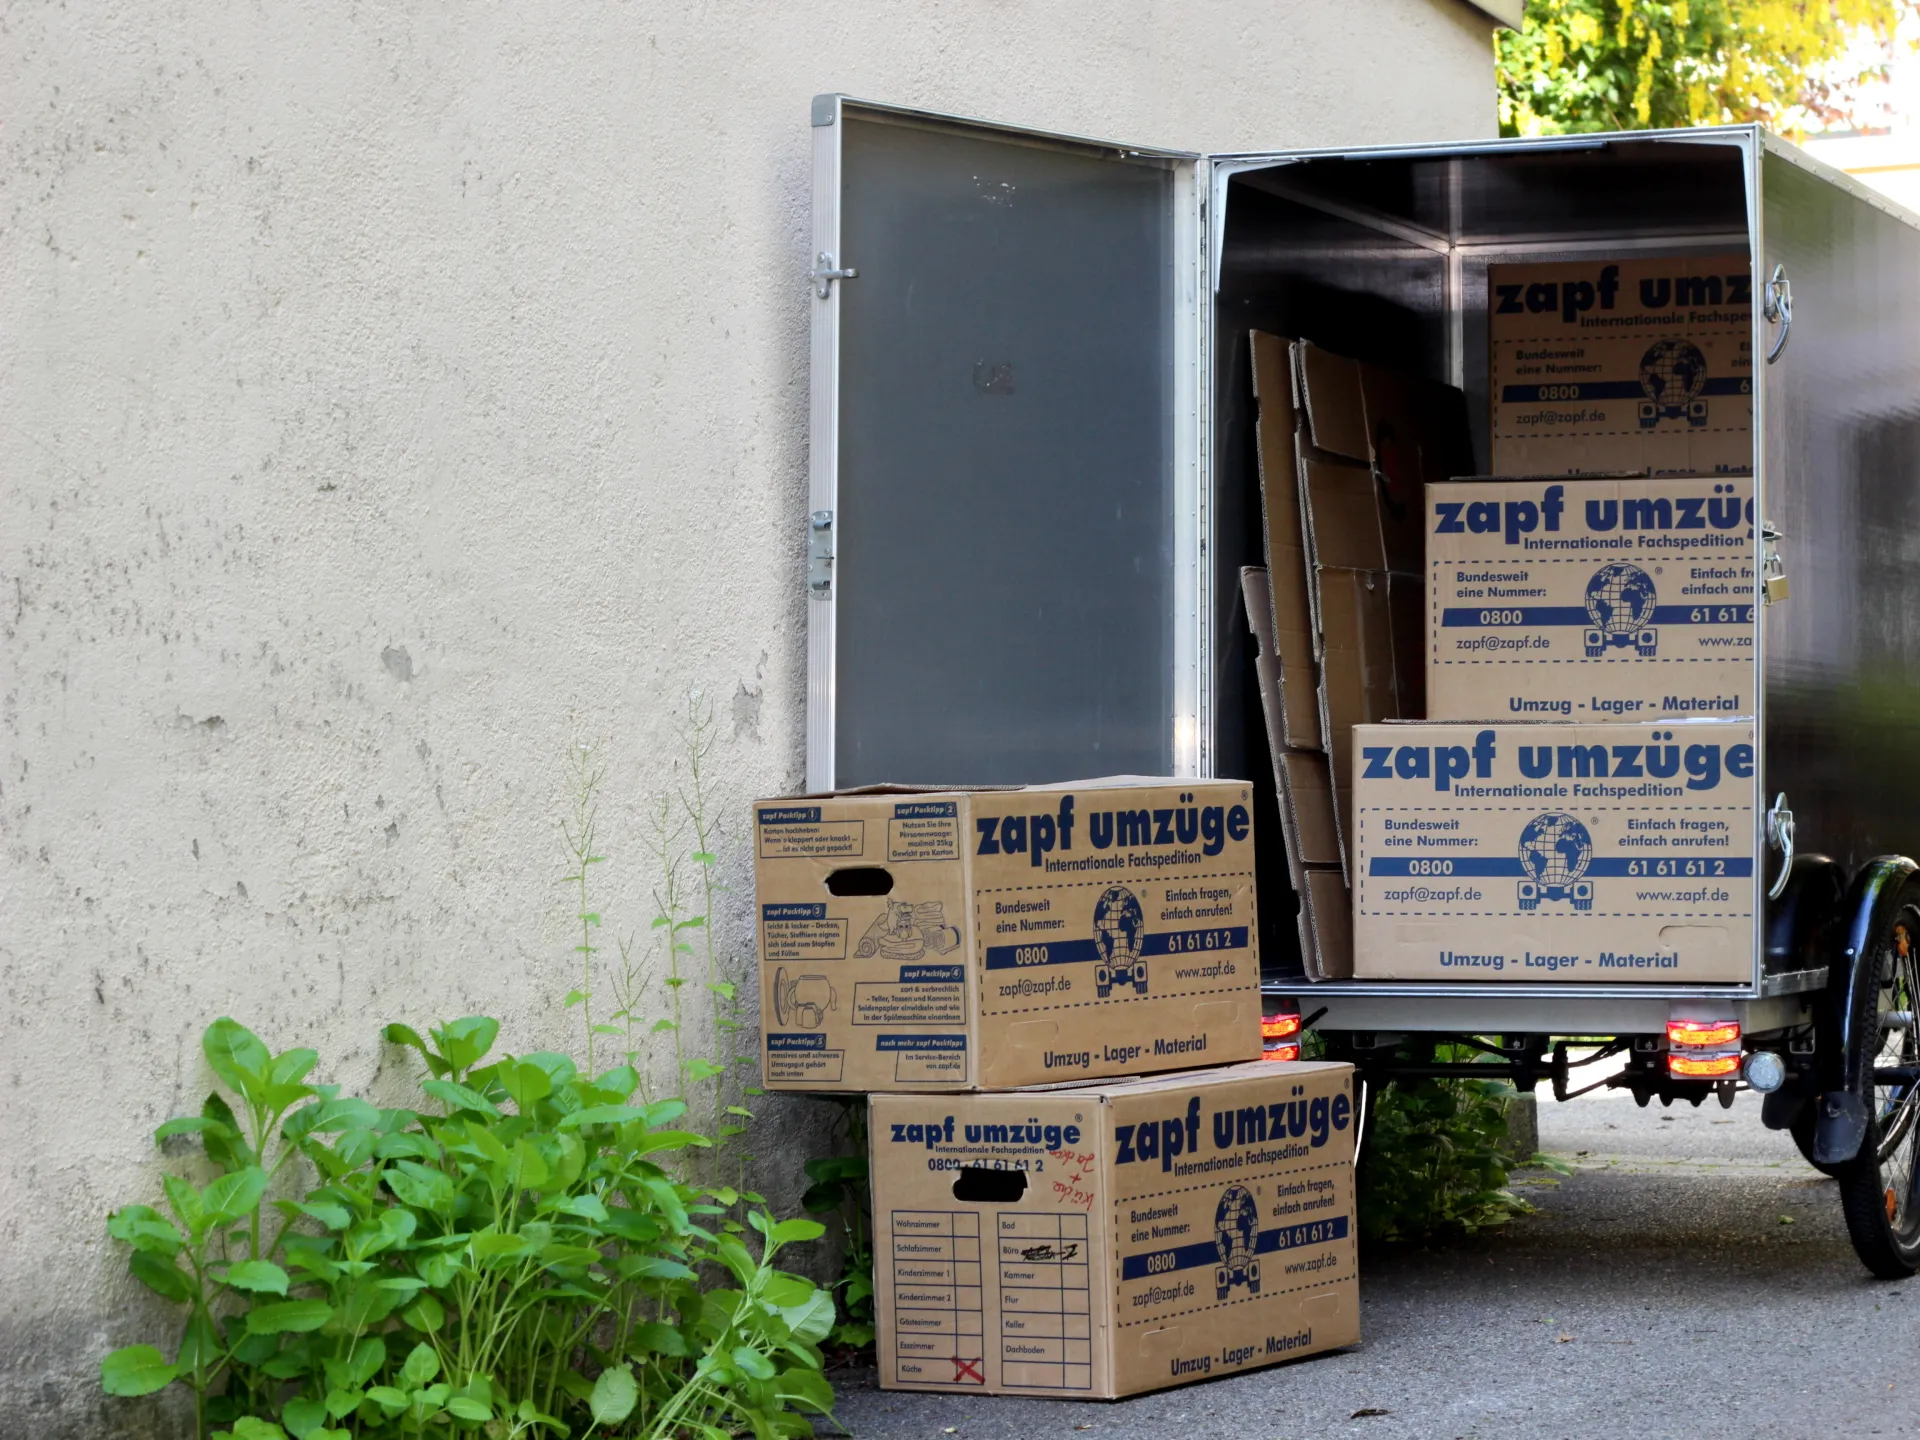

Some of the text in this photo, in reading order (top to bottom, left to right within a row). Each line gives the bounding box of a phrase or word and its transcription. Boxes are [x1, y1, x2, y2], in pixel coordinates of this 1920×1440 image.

[1495, 265, 1619, 323] zapf
[1581, 314, 1684, 328] Internationale
[1516, 349, 1584, 360] Bundesweit
[1516, 364, 1601, 375] eine Nummer:
[1539, 386, 1579, 400] 0800
[1516, 409, 1605, 425] zapf@zapf.de
[1435, 484, 1754, 545] zapf umzü
[1524, 534, 1744, 550] Internationale Fachspedition
[1457, 571, 1528, 582] Bundesweit
[1691, 568, 1737, 579] Einfach
[1457, 586, 1546, 597] eine Nummer:
[1682, 584, 1728, 594] einfach
[1480, 611, 1522, 624] 0800
[1691, 608, 1709, 622] 61
[1718, 608, 1737, 621] 61
[1456, 637, 1549, 651] zapf@zapf.de
[1510, 695, 1739, 714] Umzug Lager Material
[1362, 730, 1753, 791] zapf umzüge
[1455, 784, 1683, 799] Internationale Fachspedition
[915, 806, 944, 814] Packtipp
[976, 793, 1249, 866] zapf umzüge
[1385, 819, 1459, 830] Bundesweit
[1628, 818, 1729, 833] Einfach fragen,
[936, 839, 952, 847] 25kg
[1385, 835, 1478, 846] eine Nummer:
[1618, 835, 1729, 846] einfach anrufen!
[1045, 853, 1201, 873] Internationale Fachspedition
[1409, 860, 1453, 875] 0800
[1628, 861, 1724, 875] 61 61 61 2
[1165, 889, 1232, 902] Einfach fragen,
[1384, 887, 1481, 902] zapf@zapf.de
[1636, 888, 1729, 902] www.zapf.de
[996, 900, 1050, 914] Bundesweit
[1161, 903, 1232, 920] einfach anrufen!
[996, 919, 1065, 933] eine Nummer:
[1169, 932, 1231, 952] 61 61 61 2
[1016, 947, 1048, 964] 0800
[1440, 952, 1678, 970] Umzug Lager Material
[1175, 961, 1235, 979] www.zapf.de
[999, 977, 1071, 998] zapf@zapf.de
[1044, 1034, 1207, 1069] Umzug Lager Material
[891, 1116, 1080, 1150] zapf umzüge
[1115, 1085, 1350, 1172] zapf umzüge
[992, 1147, 1044, 1155] Fachspedition
[928, 1159, 960, 1171] 0800
[994, 1159, 1008, 1171] 61
[1036, 1160, 1043, 1171] 2
[1175, 1146, 1309, 1177] Internationale Fachspedition
[1278, 1179, 1335, 1197] Einfach fragen,
[1273, 1196, 1335, 1216] einfach anrufen!
[1131, 1205, 1178, 1223] Bundesweit
[1131, 1223, 1190, 1242] eine Nummer:
[1279, 1223, 1333, 1247] 61 61 61 2
[1147, 1252, 1175, 1272] 0800
[1285, 1253, 1337, 1274] www.zapf.de
[898, 1269, 944, 1277] Kinderzimmer
[899, 1294, 945, 1302] Kinderzimmer
[1133, 1283, 1194, 1306] zapf@zapf.de
[900, 1319, 941, 1327] Gästezimmer
[900, 1342, 934, 1350] Esszimmer
[1006, 1346, 1044, 1354] Dachboden
[1171, 1329, 1311, 1375] Umzug Lager Material
[902, 1365, 922, 1373] Küche
